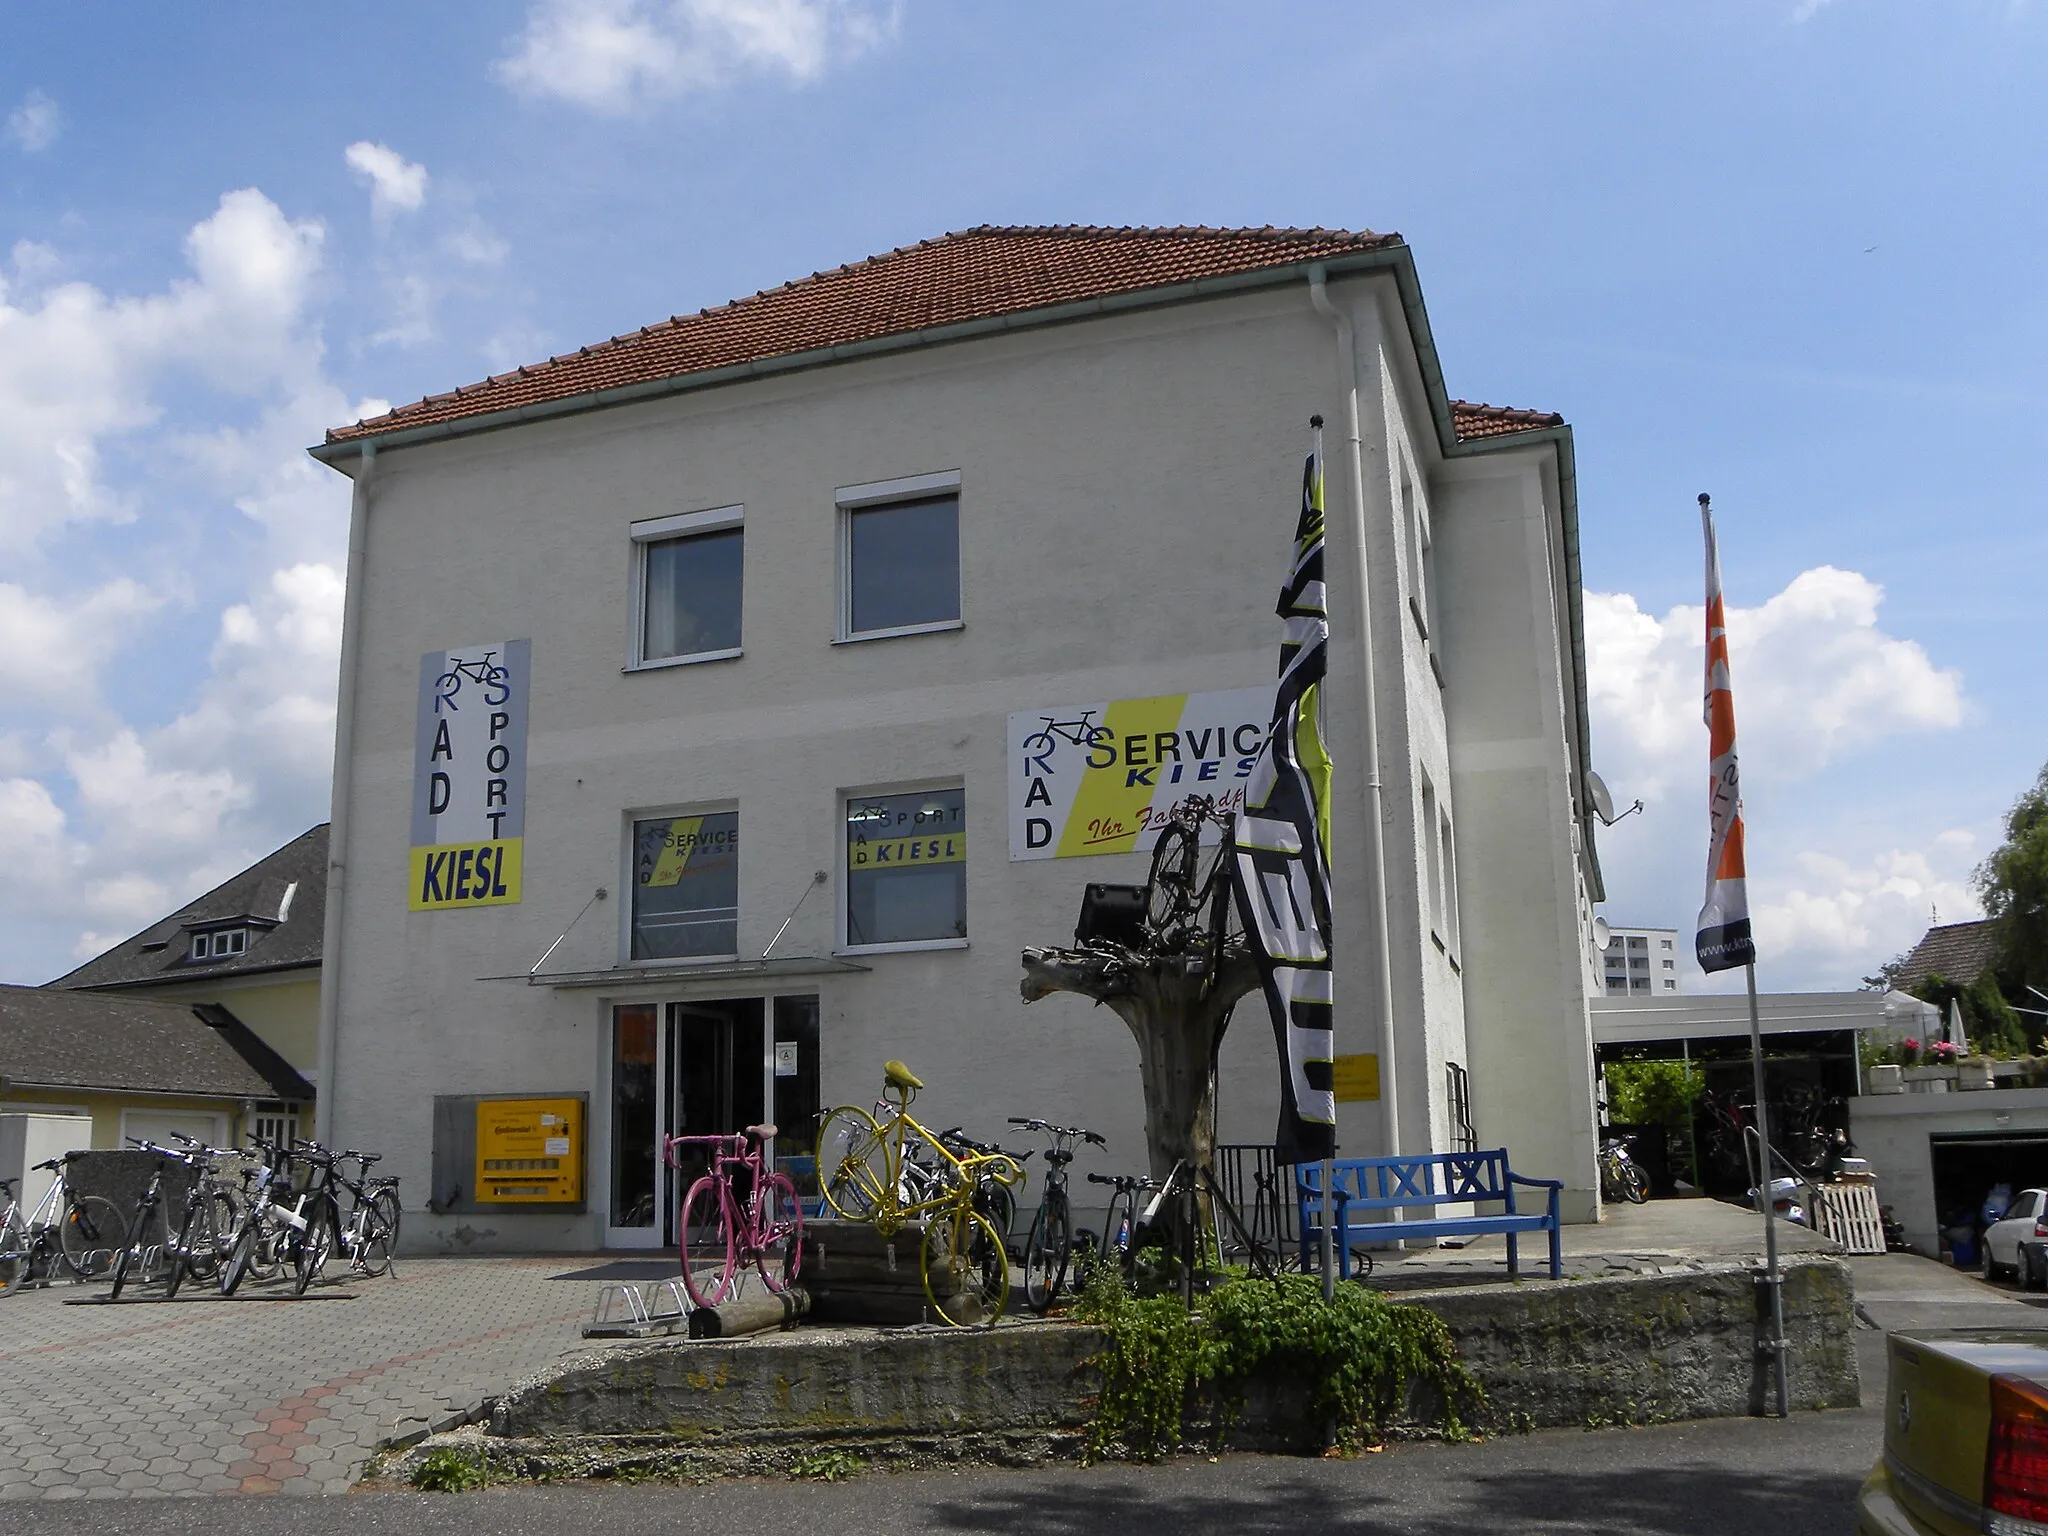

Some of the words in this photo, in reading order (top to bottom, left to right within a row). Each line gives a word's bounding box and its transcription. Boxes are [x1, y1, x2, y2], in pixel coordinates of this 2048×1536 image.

[428, 672, 462, 815] RAD
[484, 666, 510, 840] SPORT
[1086, 722, 1274, 770] SERVIC
[1023, 733, 1056, 849] RAD
[1125, 757, 1259, 788] KIES
[664, 830, 738, 848] SERVICE
[879, 807, 961, 828] SPORT
[422, 847, 507, 902] KIESL
[877, 840, 956, 862] KIESL
